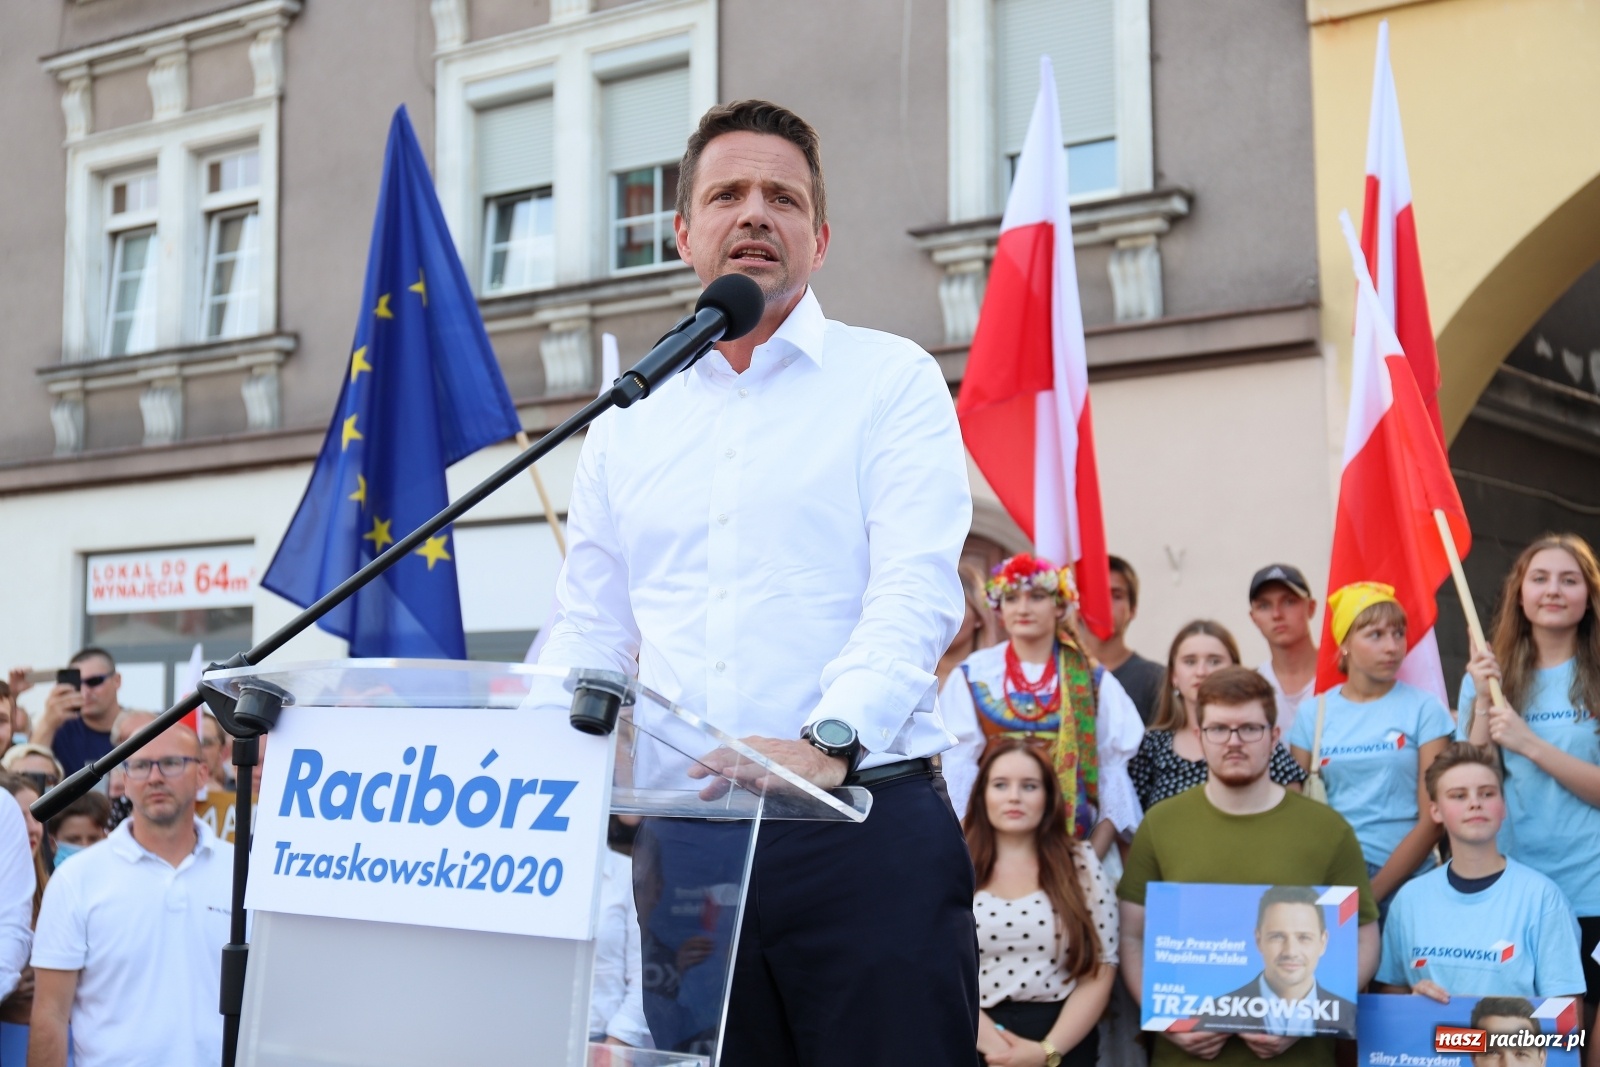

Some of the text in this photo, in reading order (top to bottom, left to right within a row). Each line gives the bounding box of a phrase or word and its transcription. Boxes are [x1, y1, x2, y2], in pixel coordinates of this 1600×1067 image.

[93, 561, 153, 582] LOKAL
[161, 559, 187, 577] DO
[92, 579, 185, 601] WYNAJĘCIA
[1320, 743, 1394, 756] ZASKOWSKI
[278, 745, 579, 831] Racibórz
[273, 841, 563, 897] Trzaskowski2020
[1155, 936, 1246, 951] Silny Prezydent
[1155, 950, 1248, 965] Wspólna Polska
[1153, 983, 1185, 994] RAFAŁ
[1152, 995, 1340, 1022] TRZASKOWSKI
[1369, 1051, 1461, 1067] Silny Prezydent
